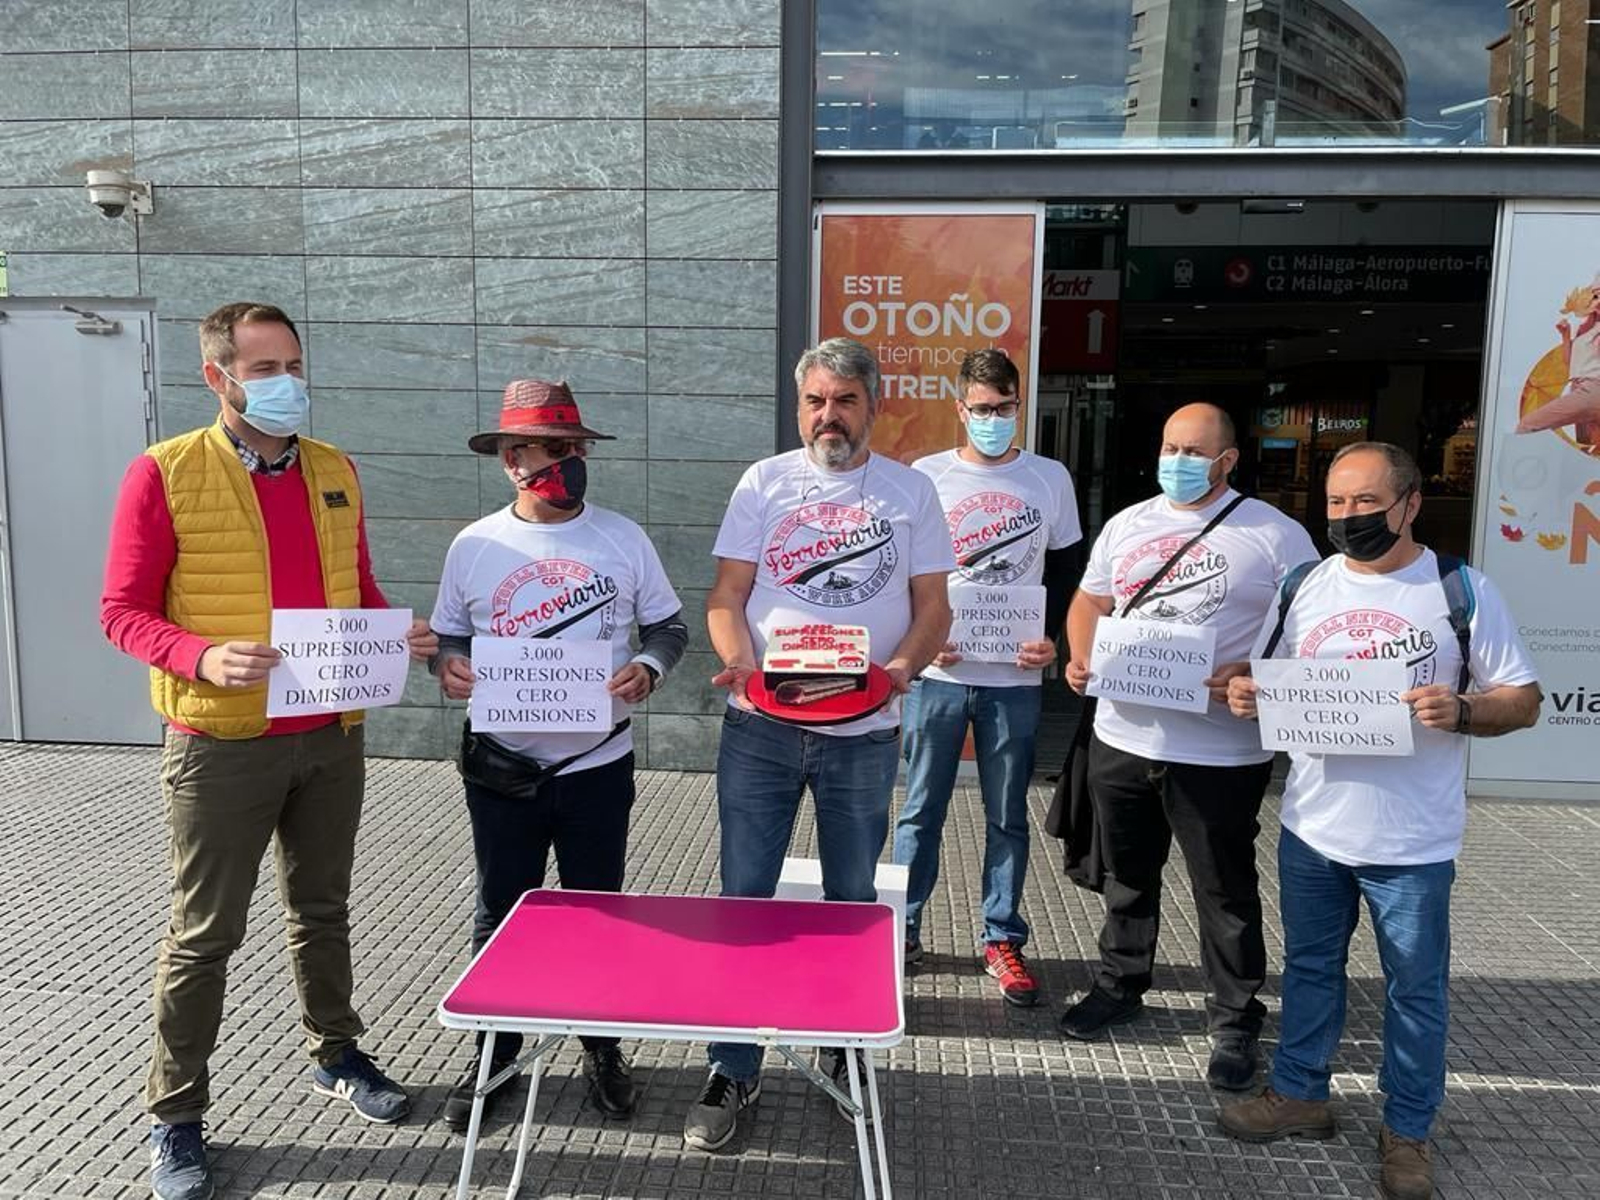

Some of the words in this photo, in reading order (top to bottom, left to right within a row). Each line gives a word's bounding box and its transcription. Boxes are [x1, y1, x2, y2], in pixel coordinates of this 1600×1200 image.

[1267, 256, 1286, 270] C1
[843, 275, 903, 295] ESTE
[1265, 276, 1287, 291] C2
[843, 292, 1012, 338] OTOÑO
[950, 506, 1041, 553] erroviario
[764, 517, 892, 577] Ferroviario
[490, 574, 618, 637] Ferroviario
[975, 592, 1008, 604] 3.000
[324, 618, 368, 634] 3.000
[971, 625, 1011, 637] CERO
[1348, 628, 1374, 638] CGT
[1518, 625, 1590, 638] Conectamos
[1136, 627, 1172, 643] 3.000
[279, 639, 405, 658] SUPRESIONES
[520, 646, 563, 661] 3.000
[1098, 641, 1208, 666] SUPRESIONES
[318, 663, 369, 681] CERO
[477, 667, 606, 682] SUPRESIONES
[1127, 663, 1171, 680] CERO
[1303, 668, 1350, 682] 3.000
[285, 683, 392, 705] DIMISIONES
[516, 688, 568, 702] CERO
[1100, 677, 1195, 702] DIMISIONES
[1261, 688, 1400, 705] SUPRESIONES
[487, 709, 597, 723] DIMISIONES
[1304, 710, 1359, 725] CERO
[1548, 716, 1591, 726] CENTRO
[1276, 728, 1395, 747] DIMISIONES
